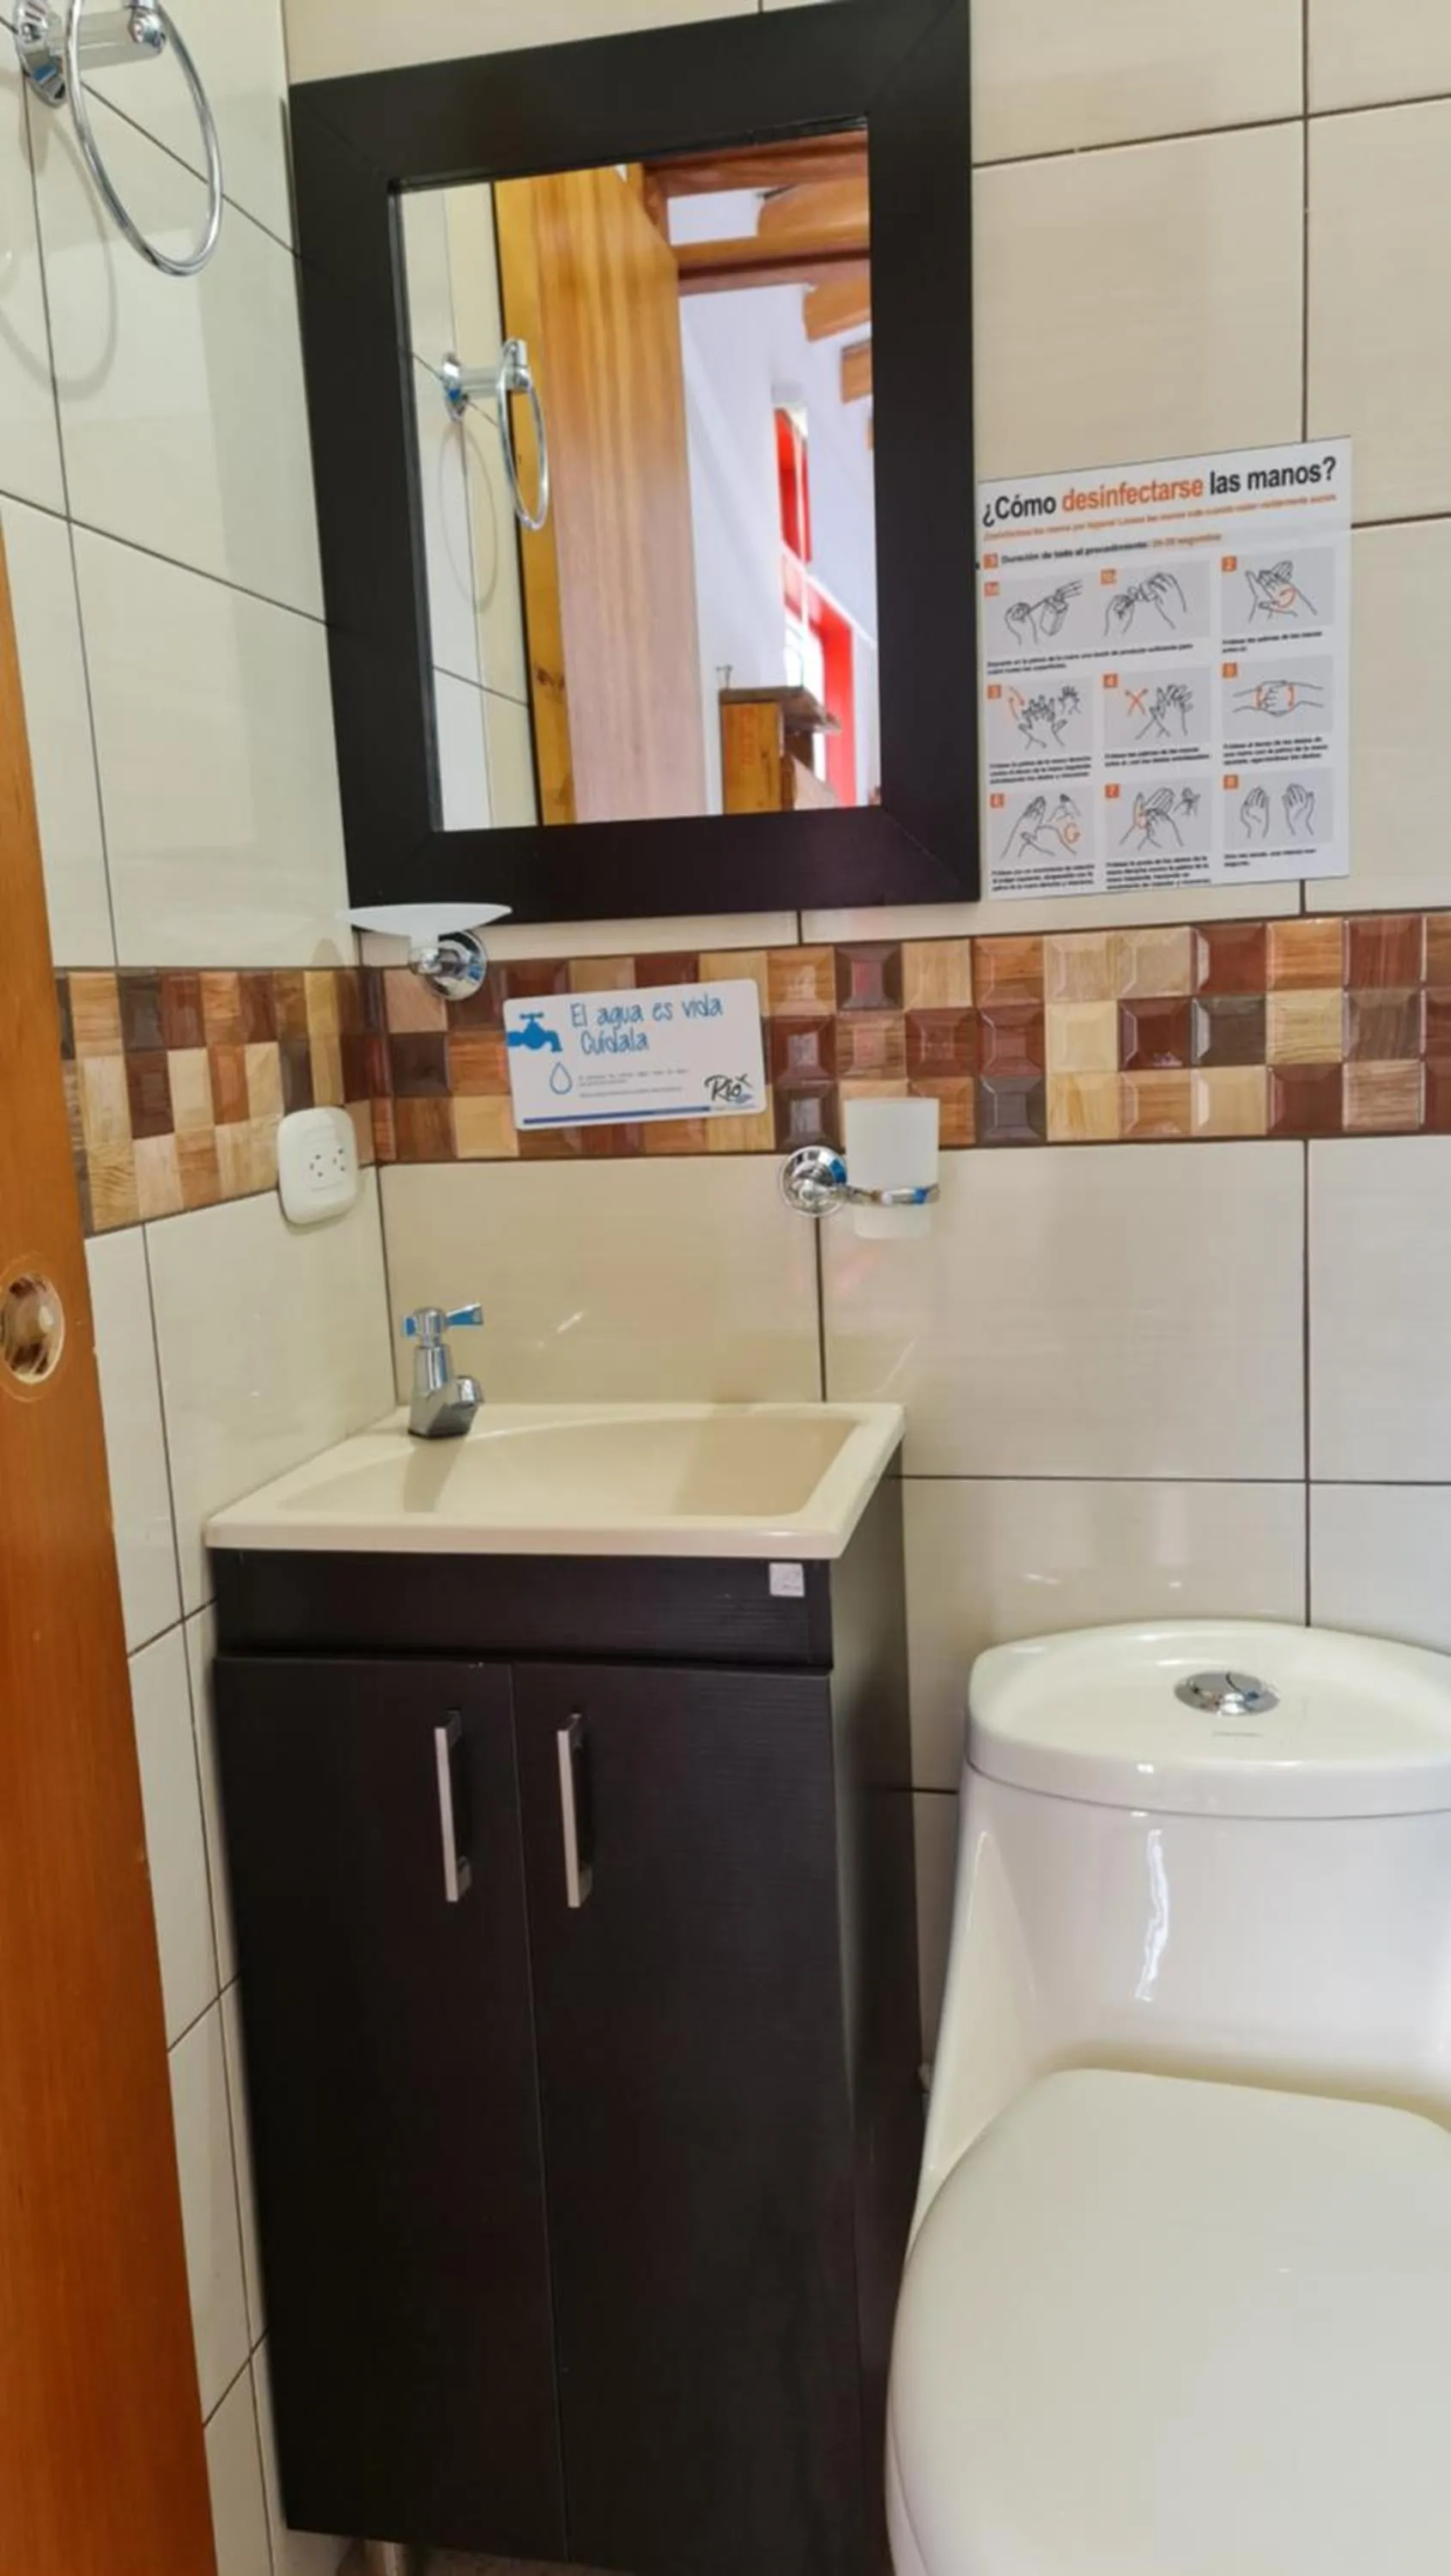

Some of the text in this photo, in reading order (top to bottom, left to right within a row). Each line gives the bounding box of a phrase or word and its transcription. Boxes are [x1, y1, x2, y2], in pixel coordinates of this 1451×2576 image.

[982, 494, 1056, 527] ¿Cómo
[1062, 477, 1205, 513] desinfectarse
[1210, 470, 1241, 495] las
[1248, 456, 1336, 491] manos?
[570, 993, 723, 1030] El agua es vida
[580, 1027, 649, 1055] Cuídala
